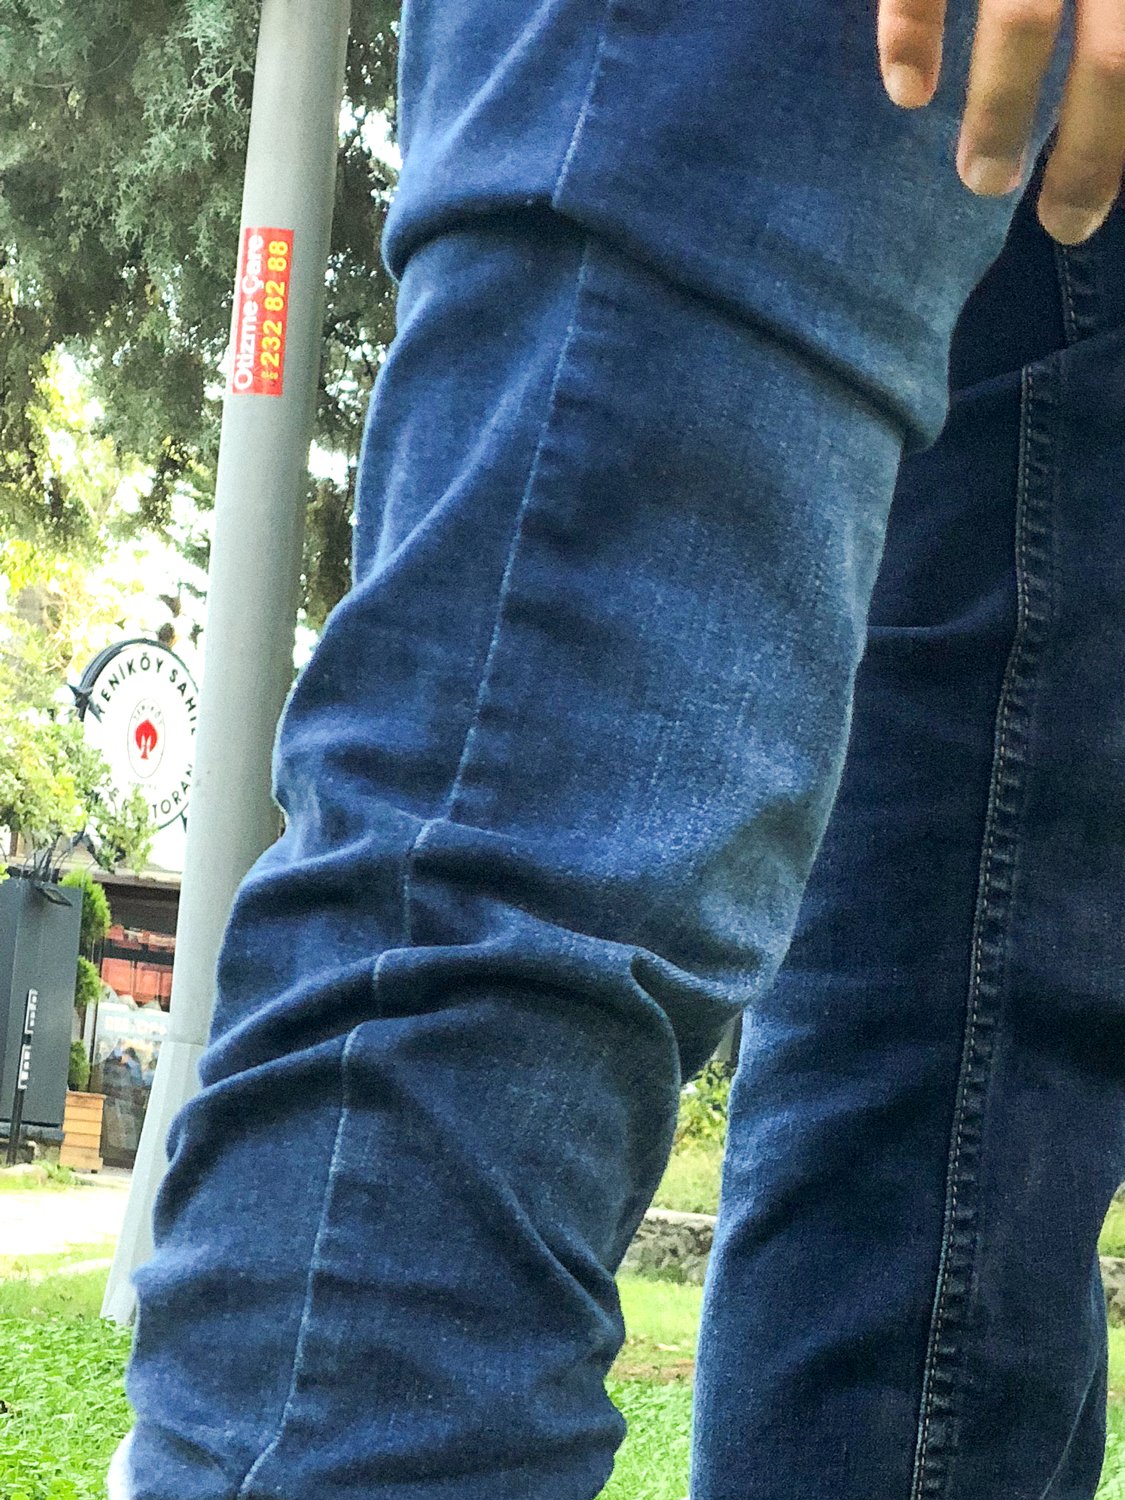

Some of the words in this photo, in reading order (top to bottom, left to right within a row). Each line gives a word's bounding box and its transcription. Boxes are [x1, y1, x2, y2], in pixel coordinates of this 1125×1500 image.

[242, 234, 264, 295] Çare
[267, 240, 289, 272] 88
[264, 281, 286, 312] 82
[234, 300, 258, 390] Otizme
[260, 320, 283, 368] 232
